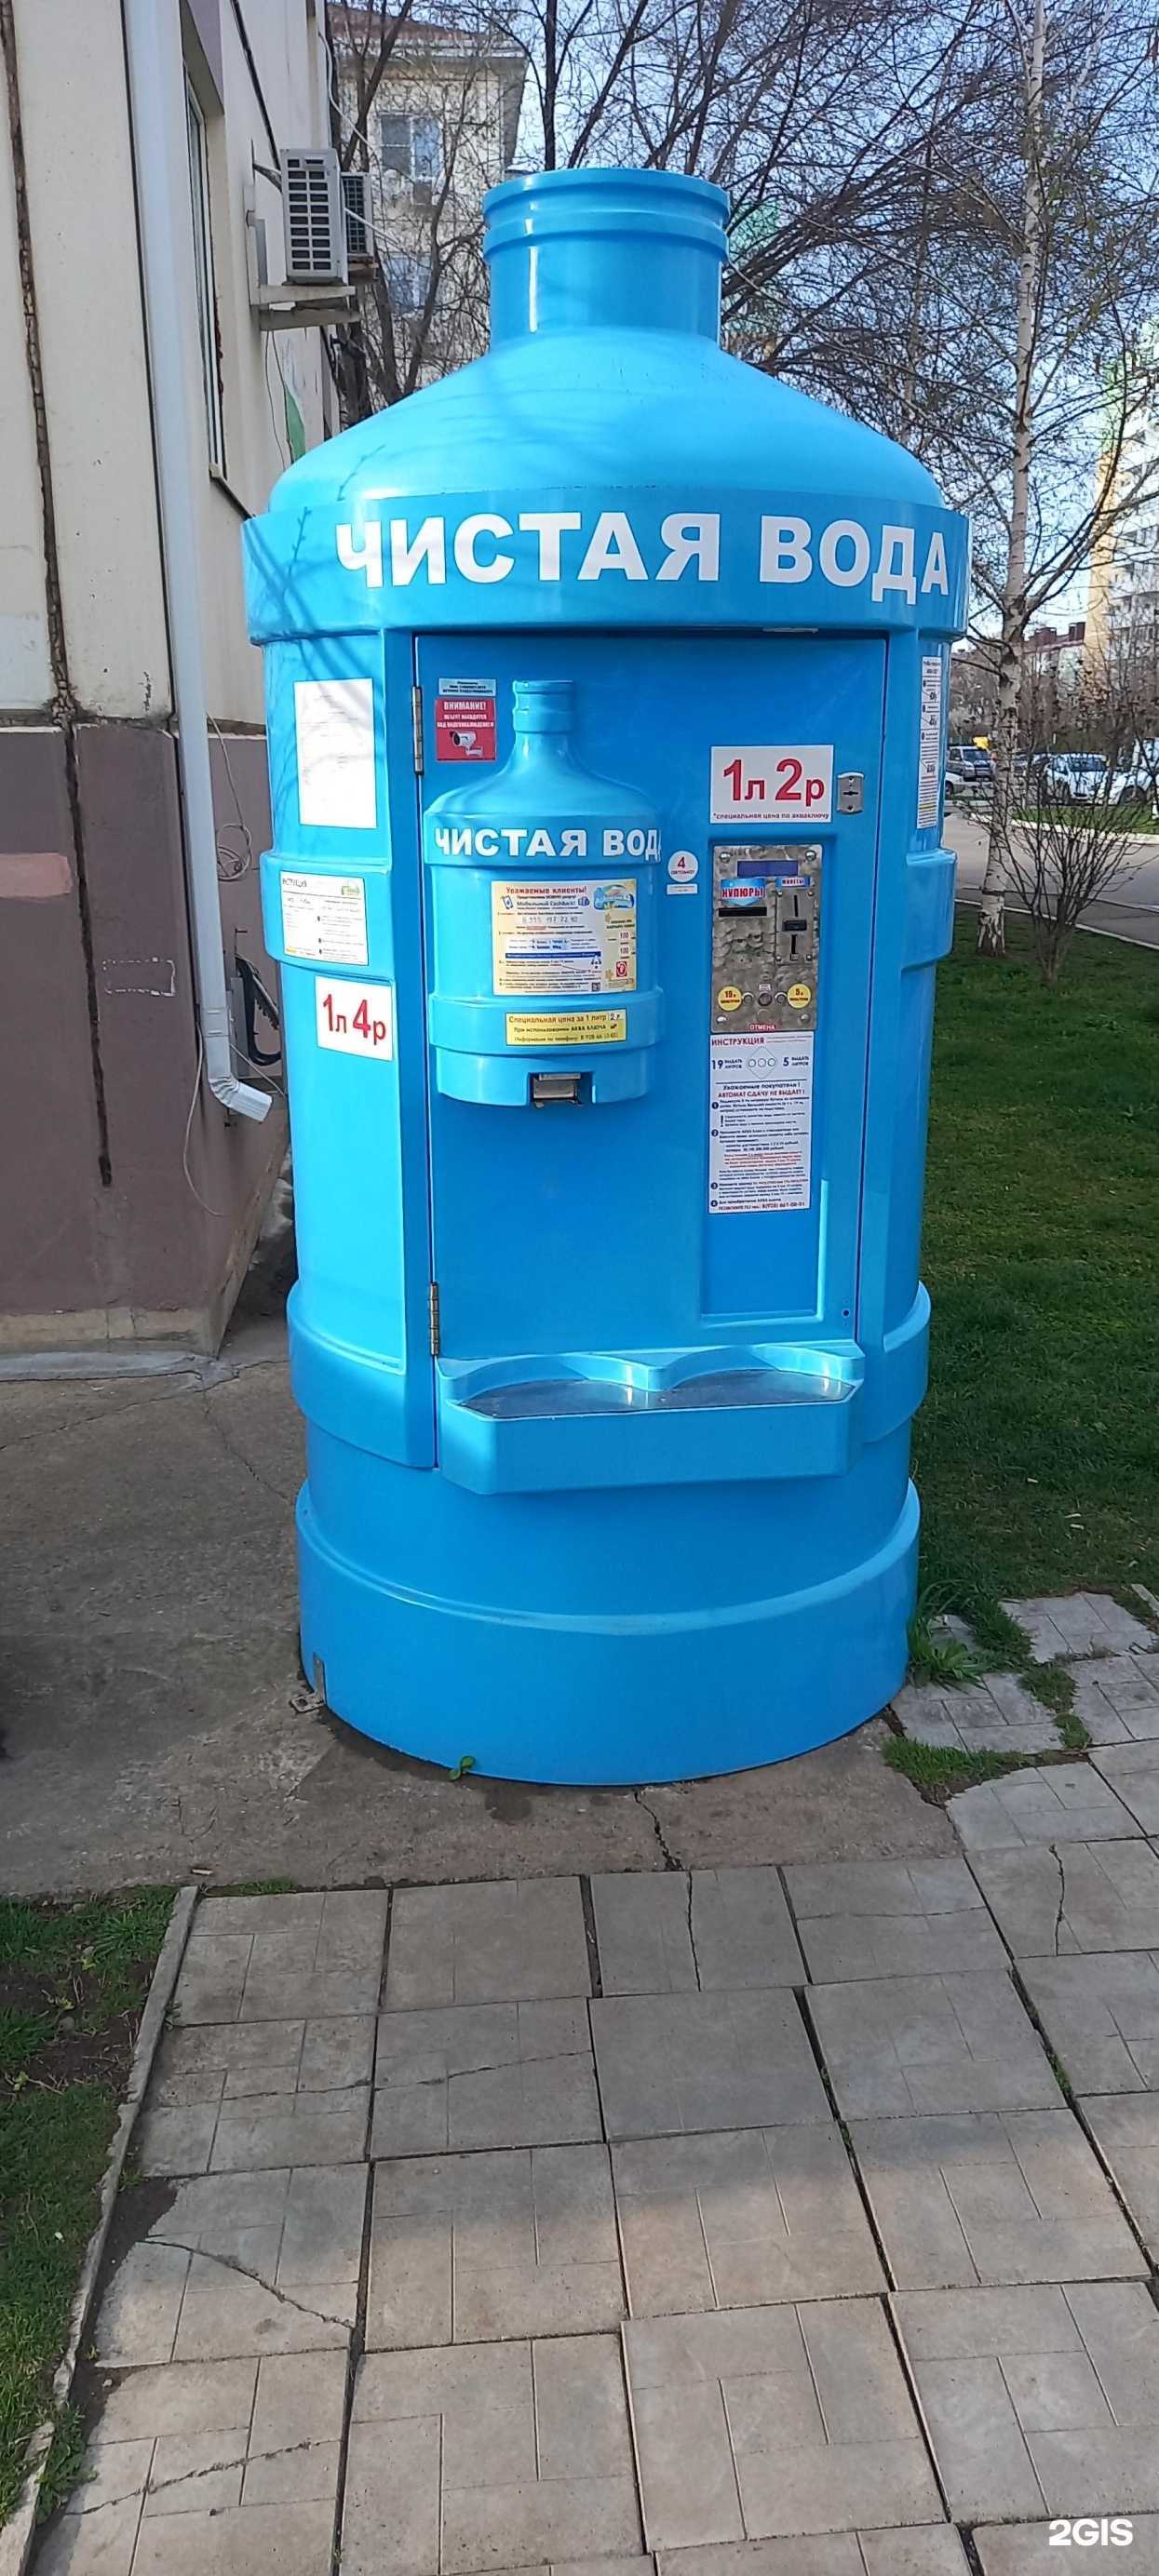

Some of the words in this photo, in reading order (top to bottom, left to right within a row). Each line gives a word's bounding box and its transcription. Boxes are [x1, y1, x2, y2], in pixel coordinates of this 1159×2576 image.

[336, 512, 721, 588] ЧИСТАЯ
[759, 515, 950, 605] ВОДА
[723, 758, 765, 801] 1л
[775, 758, 826, 807] 2р
[435, 827, 587, 856] ЧИСТАЯ
[677, 856, 687, 869] 4
[323, 994, 347, 1034] 1л
[353, 999, 386, 1045] 4р
[711, 1037, 764, 1046] ИНСТРУКЦИЯ
[712, 1059, 724, 1069] 19
[783, 1057, 789, 1067] 5
